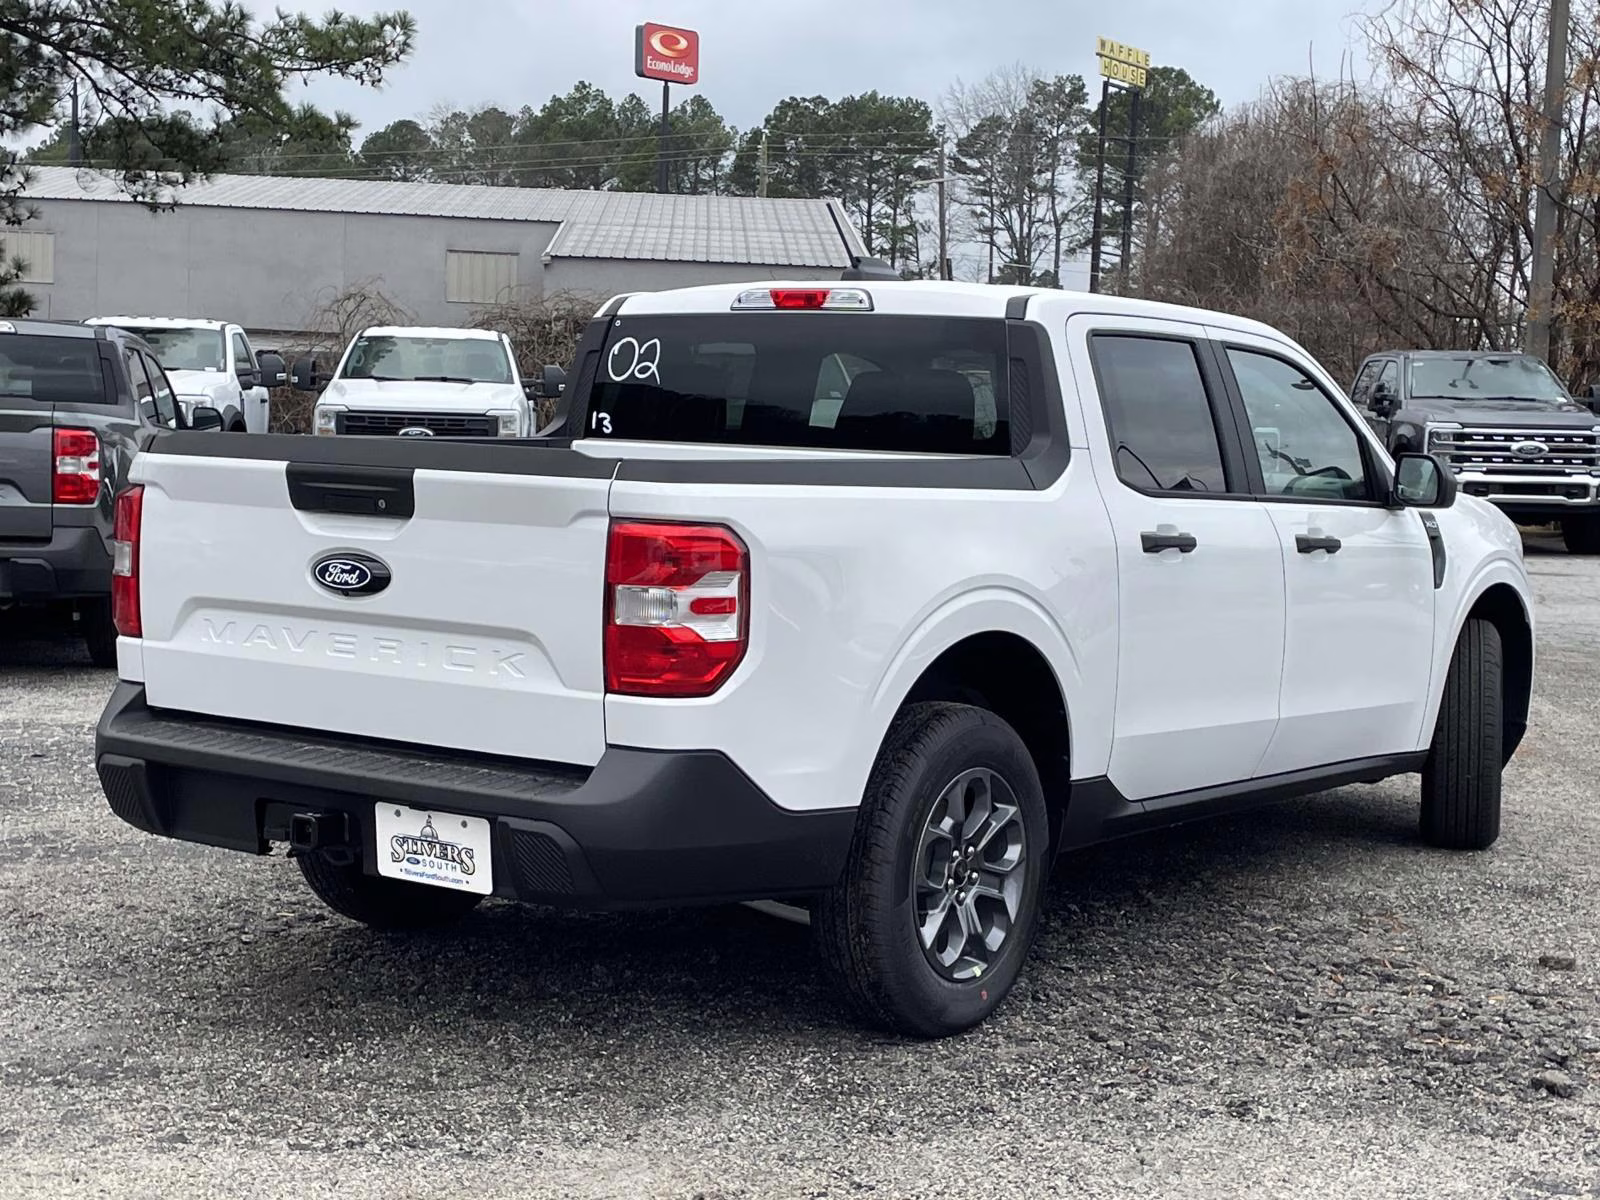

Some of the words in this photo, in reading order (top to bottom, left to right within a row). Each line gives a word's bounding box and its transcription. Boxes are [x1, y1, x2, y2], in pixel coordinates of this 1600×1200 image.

[1100, 38, 1150, 67] WAFFLE
[1103, 60, 1145, 84] HOUSE
[608, 336, 661, 385] 02
[591, 411, 612, 434] 13
[325, 563, 360, 584] Ford
[201, 618, 526, 679] MAVERICK
[390, 835, 475, 876] STIVERS
[421, 858, 457, 872] SOUTH
